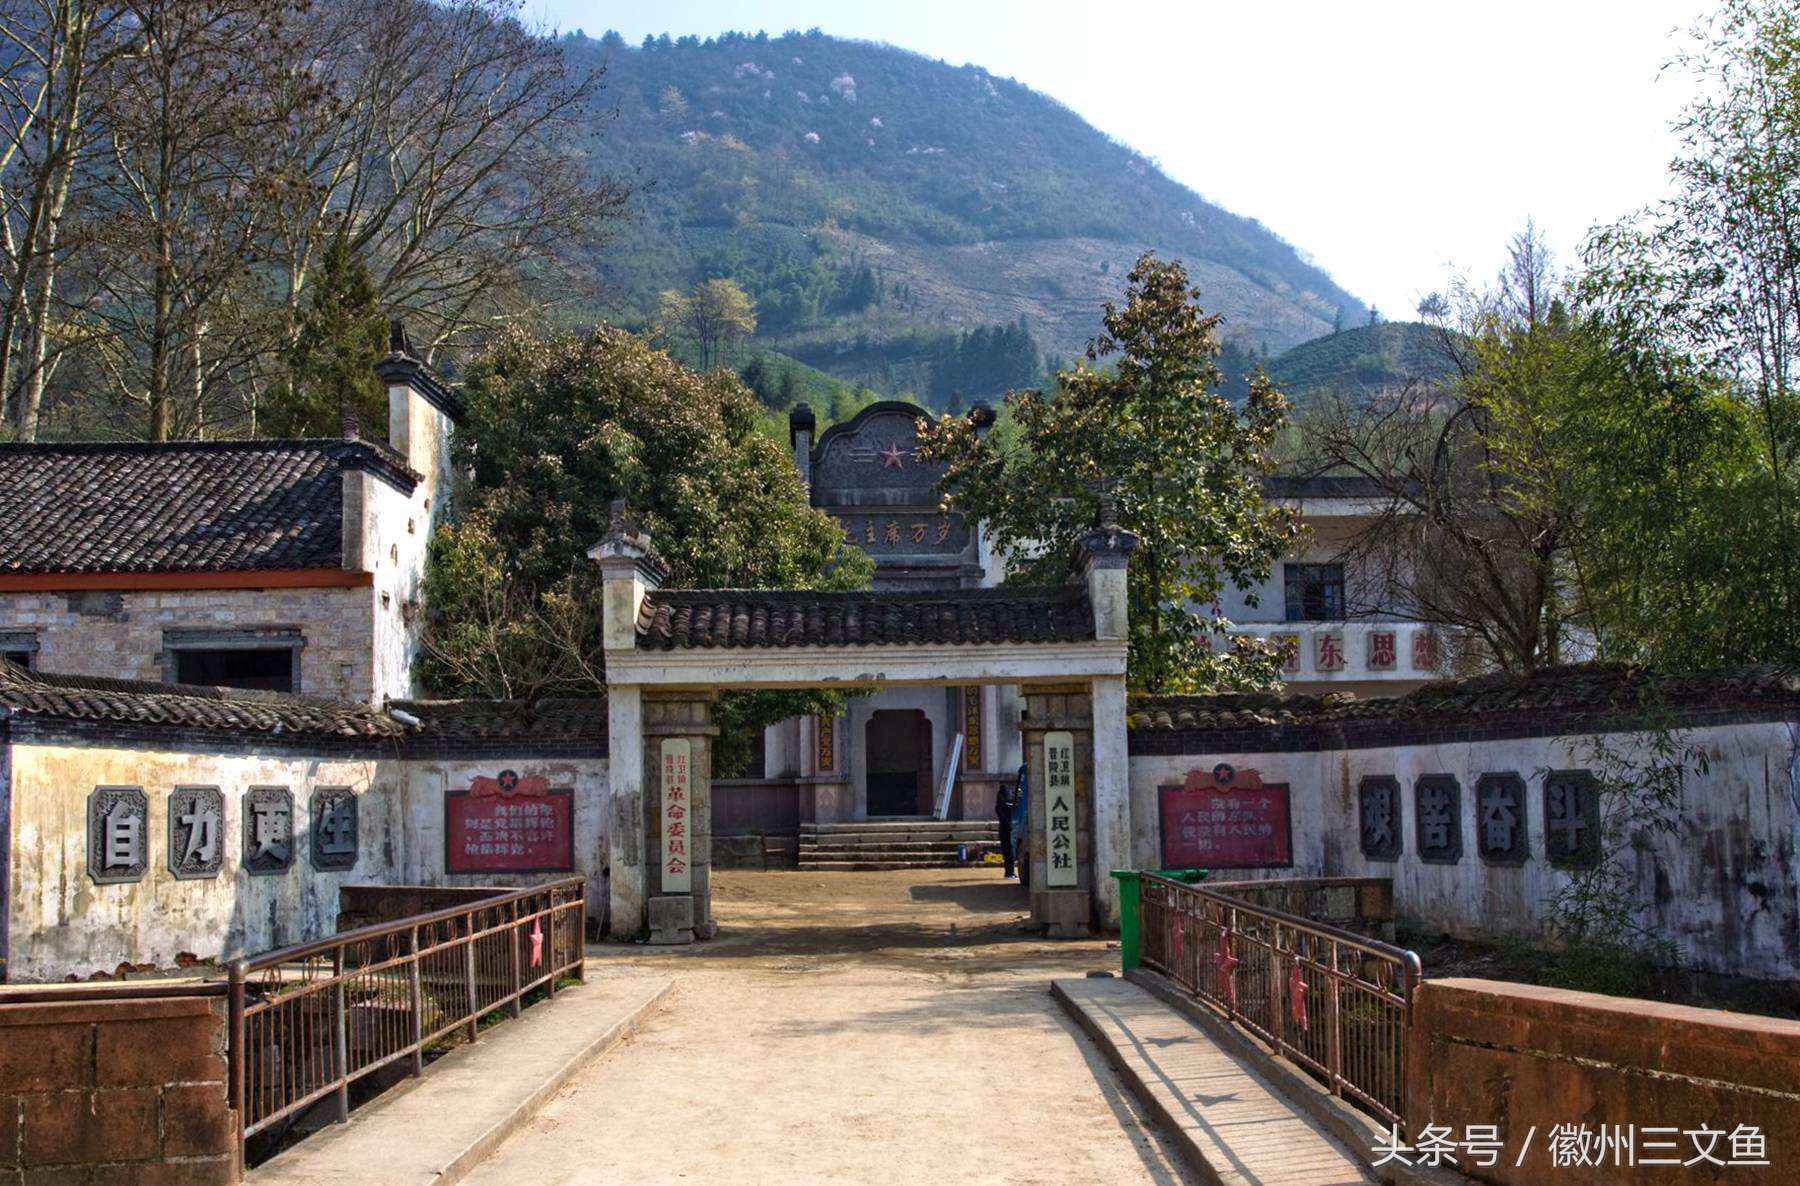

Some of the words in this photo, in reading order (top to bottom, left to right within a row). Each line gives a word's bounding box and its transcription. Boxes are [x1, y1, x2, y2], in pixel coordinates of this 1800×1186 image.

[103, 799, 355, 870] 自力更生
[667, 786, 687, 874] 革命委员会
[1051, 796, 1073, 869] 人民公社
[1365, 784, 1587, 852] 艰苦奋斗
